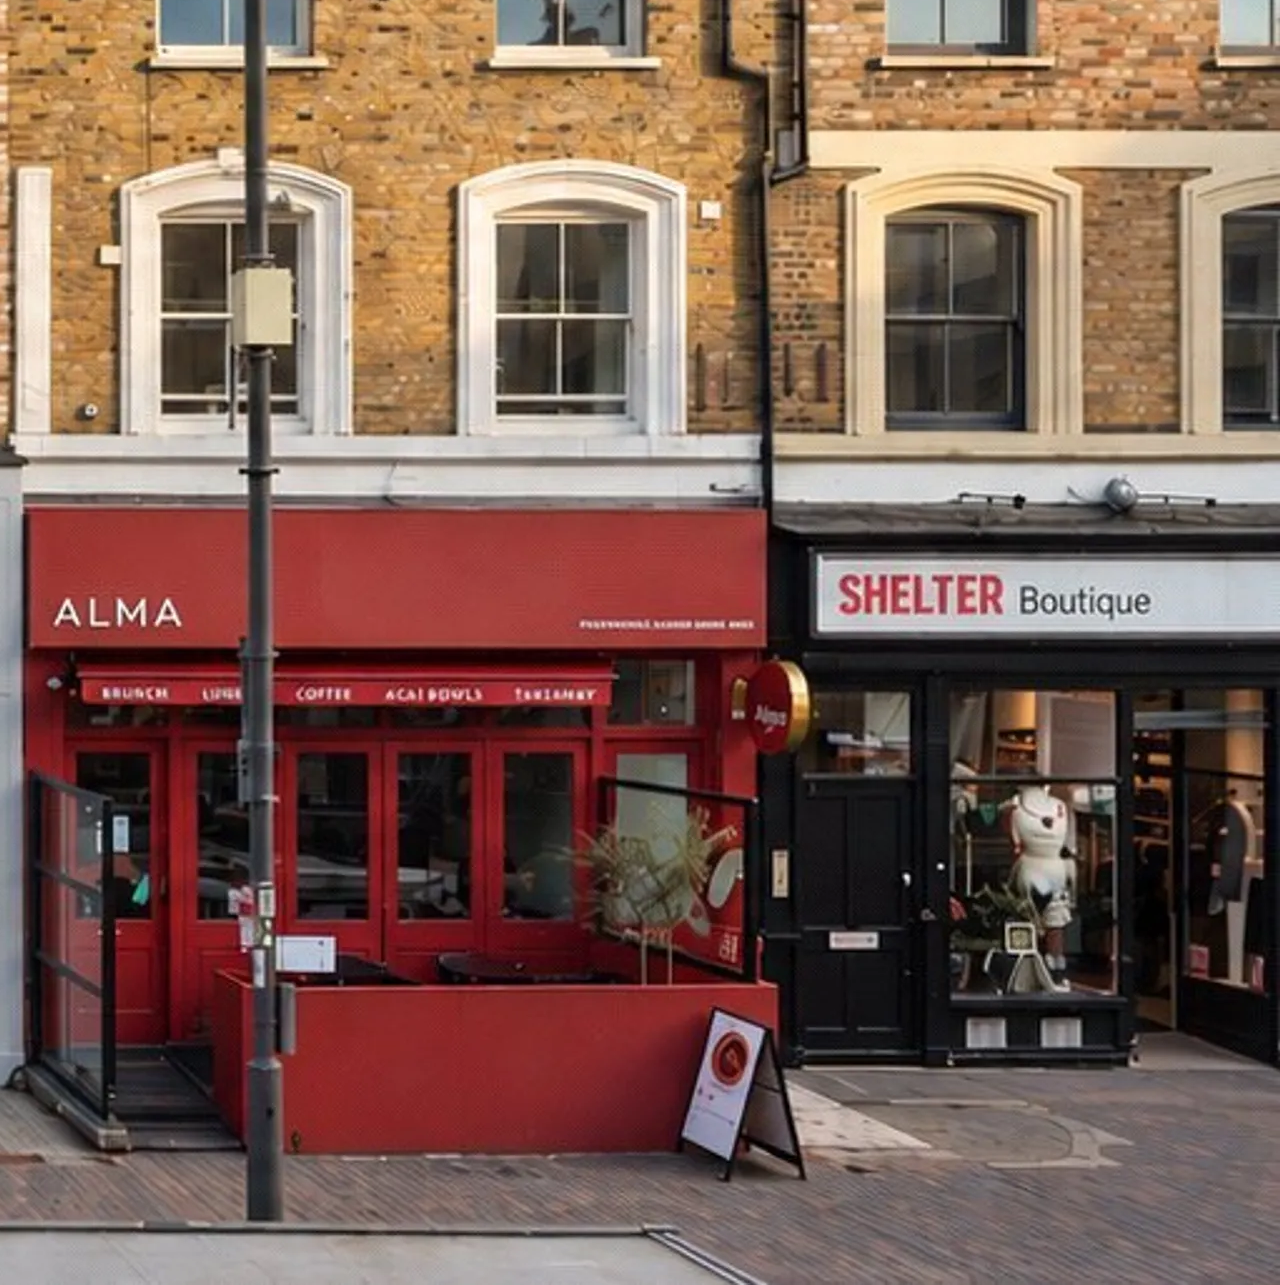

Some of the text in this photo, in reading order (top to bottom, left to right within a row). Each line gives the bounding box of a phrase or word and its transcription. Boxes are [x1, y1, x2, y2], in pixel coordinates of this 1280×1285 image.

[53, 597, 182, 628] ALMA
[838, 574, 1151, 620] SHELTER Boutique
